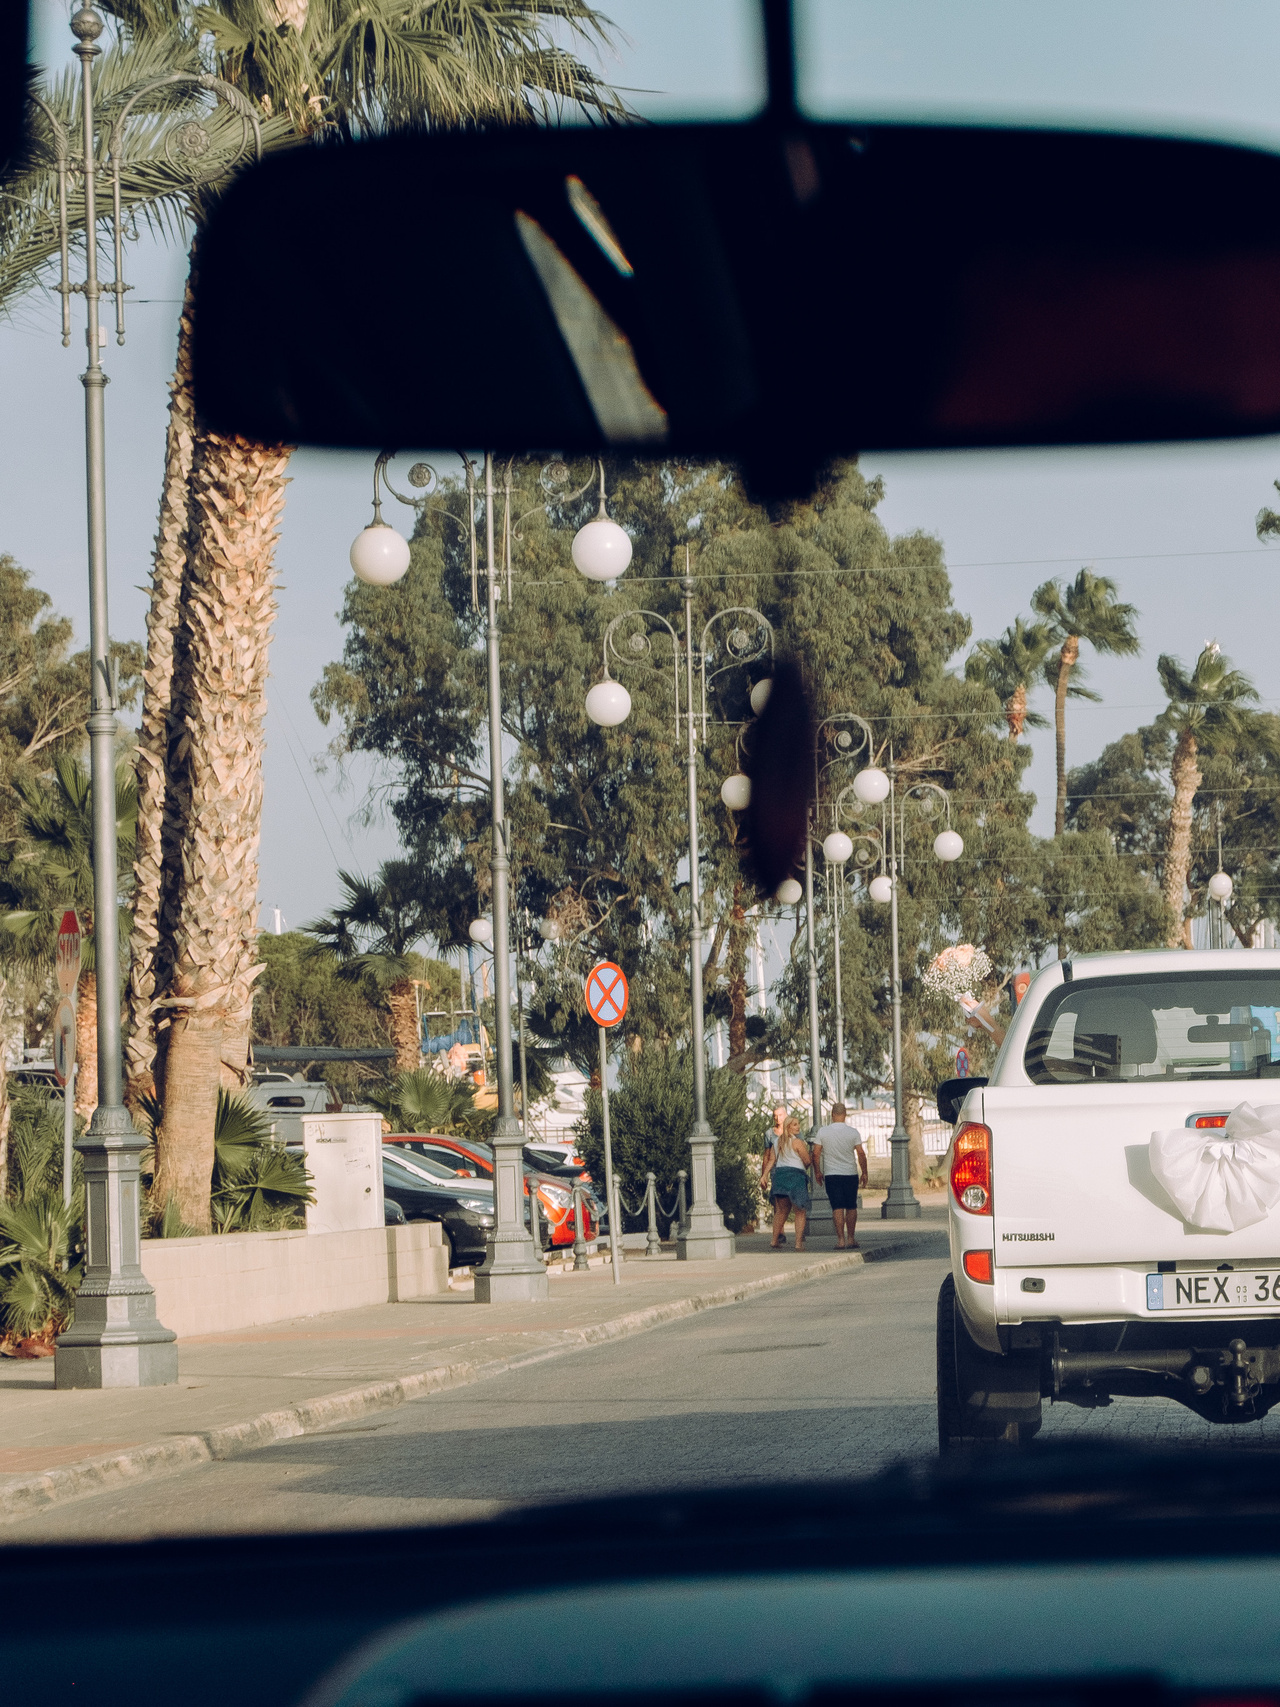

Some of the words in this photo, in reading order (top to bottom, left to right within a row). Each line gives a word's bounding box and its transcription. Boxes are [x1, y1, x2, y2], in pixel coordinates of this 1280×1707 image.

[57, 932, 80, 971] STOP
[1002, 1232, 1055, 1241] MITSUBISHI
[1175, 1276, 1231, 1304] NEX
[1236, 1285, 1248, 1293] 03
[1237, 1295, 1248, 1303] 13
